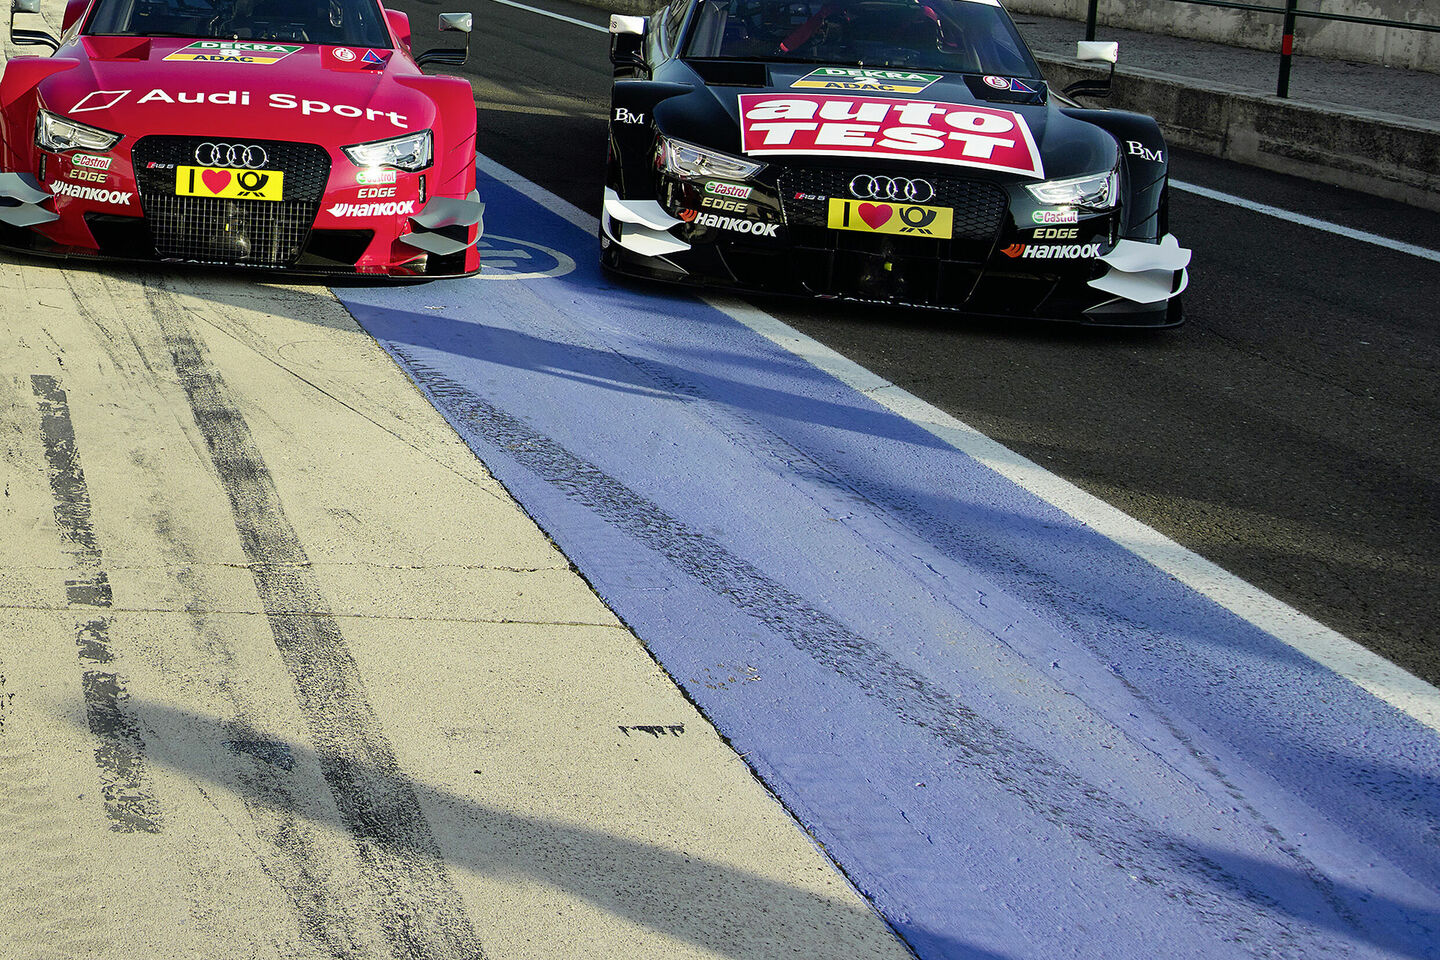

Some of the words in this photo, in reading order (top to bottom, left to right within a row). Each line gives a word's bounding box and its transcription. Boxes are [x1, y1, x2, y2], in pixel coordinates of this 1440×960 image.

[200, 42, 290, 52] DEKRA
[193, 55, 254, 63] ADAC
[825, 69, 930, 82] DEKRA
[825, 82, 895, 91] ADAC
[137, 89, 250, 105] Audi
[268, 93, 409, 129] Sport
[745, 98, 1015, 134] auto
[748, 122, 1016, 159] TEST
[80, 155, 110, 170] Castrol
[69, 169, 108, 183] EDGE
[188, 168, 196, 193] I
[357, 187, 397, 199] EDGE
[714, 183, 750, 198] Castrol
[701, 197, 749, 213] EDGE
[842, 201, 851, 228] I
[1032, 228, 1079, 239] EDGE
